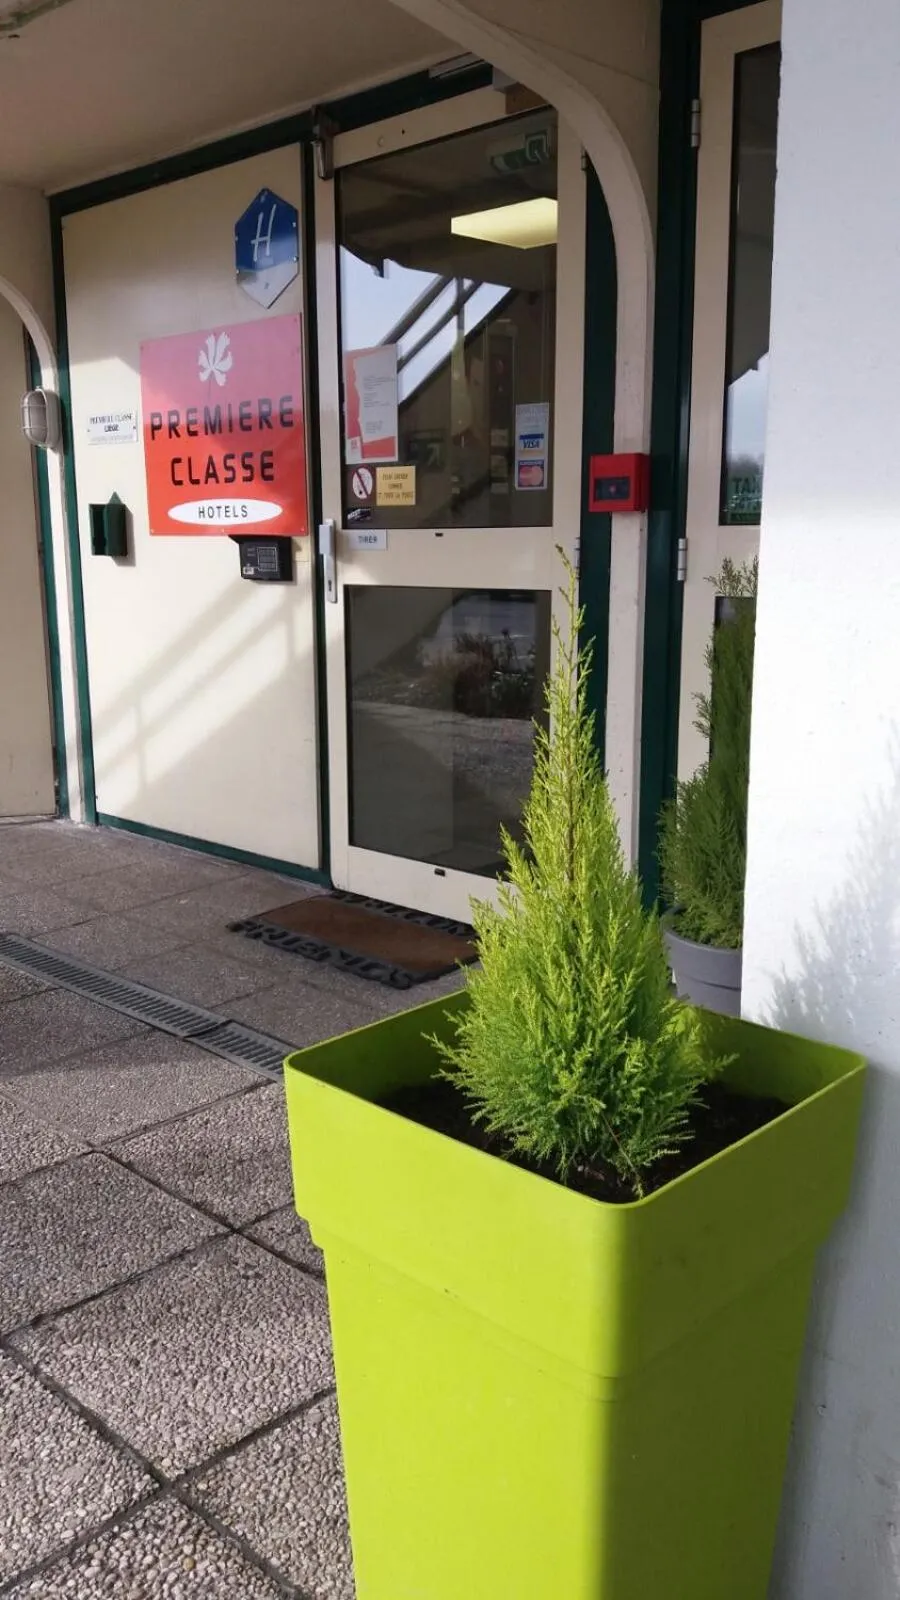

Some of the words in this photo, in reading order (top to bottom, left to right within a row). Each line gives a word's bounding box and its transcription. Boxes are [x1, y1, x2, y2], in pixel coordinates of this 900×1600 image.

[150, 395, 294, 441] PREMIERE
[171, 450, 274, 486] CLASSE
[198, 505, 249, 519] HOTELS
